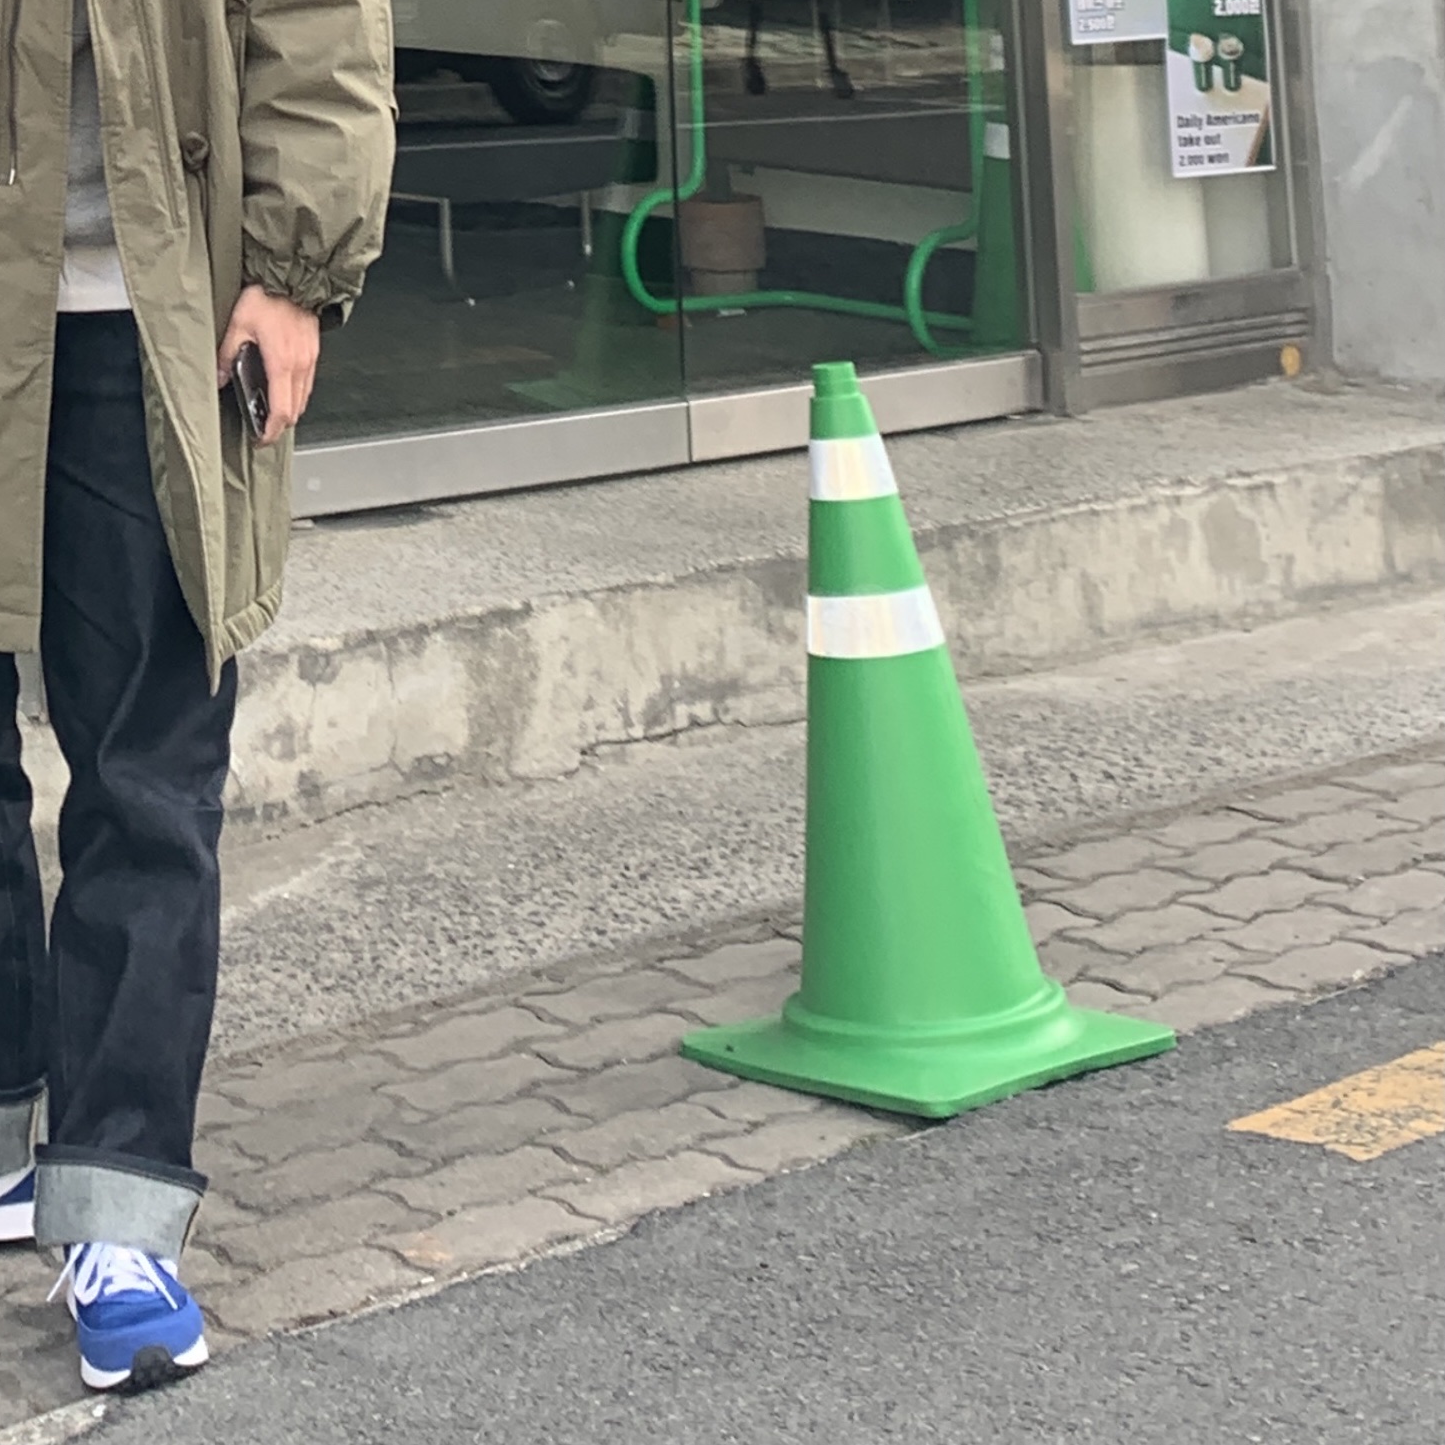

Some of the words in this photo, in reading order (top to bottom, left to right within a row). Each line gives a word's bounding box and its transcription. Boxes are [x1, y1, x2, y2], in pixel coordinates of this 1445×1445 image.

[1177, 114, 1203, 130] Daily
[1206, 113, 1260, 126] Americano
[1177, 135, 1201, 147] take
[1204, 133, 1220, 145] out
